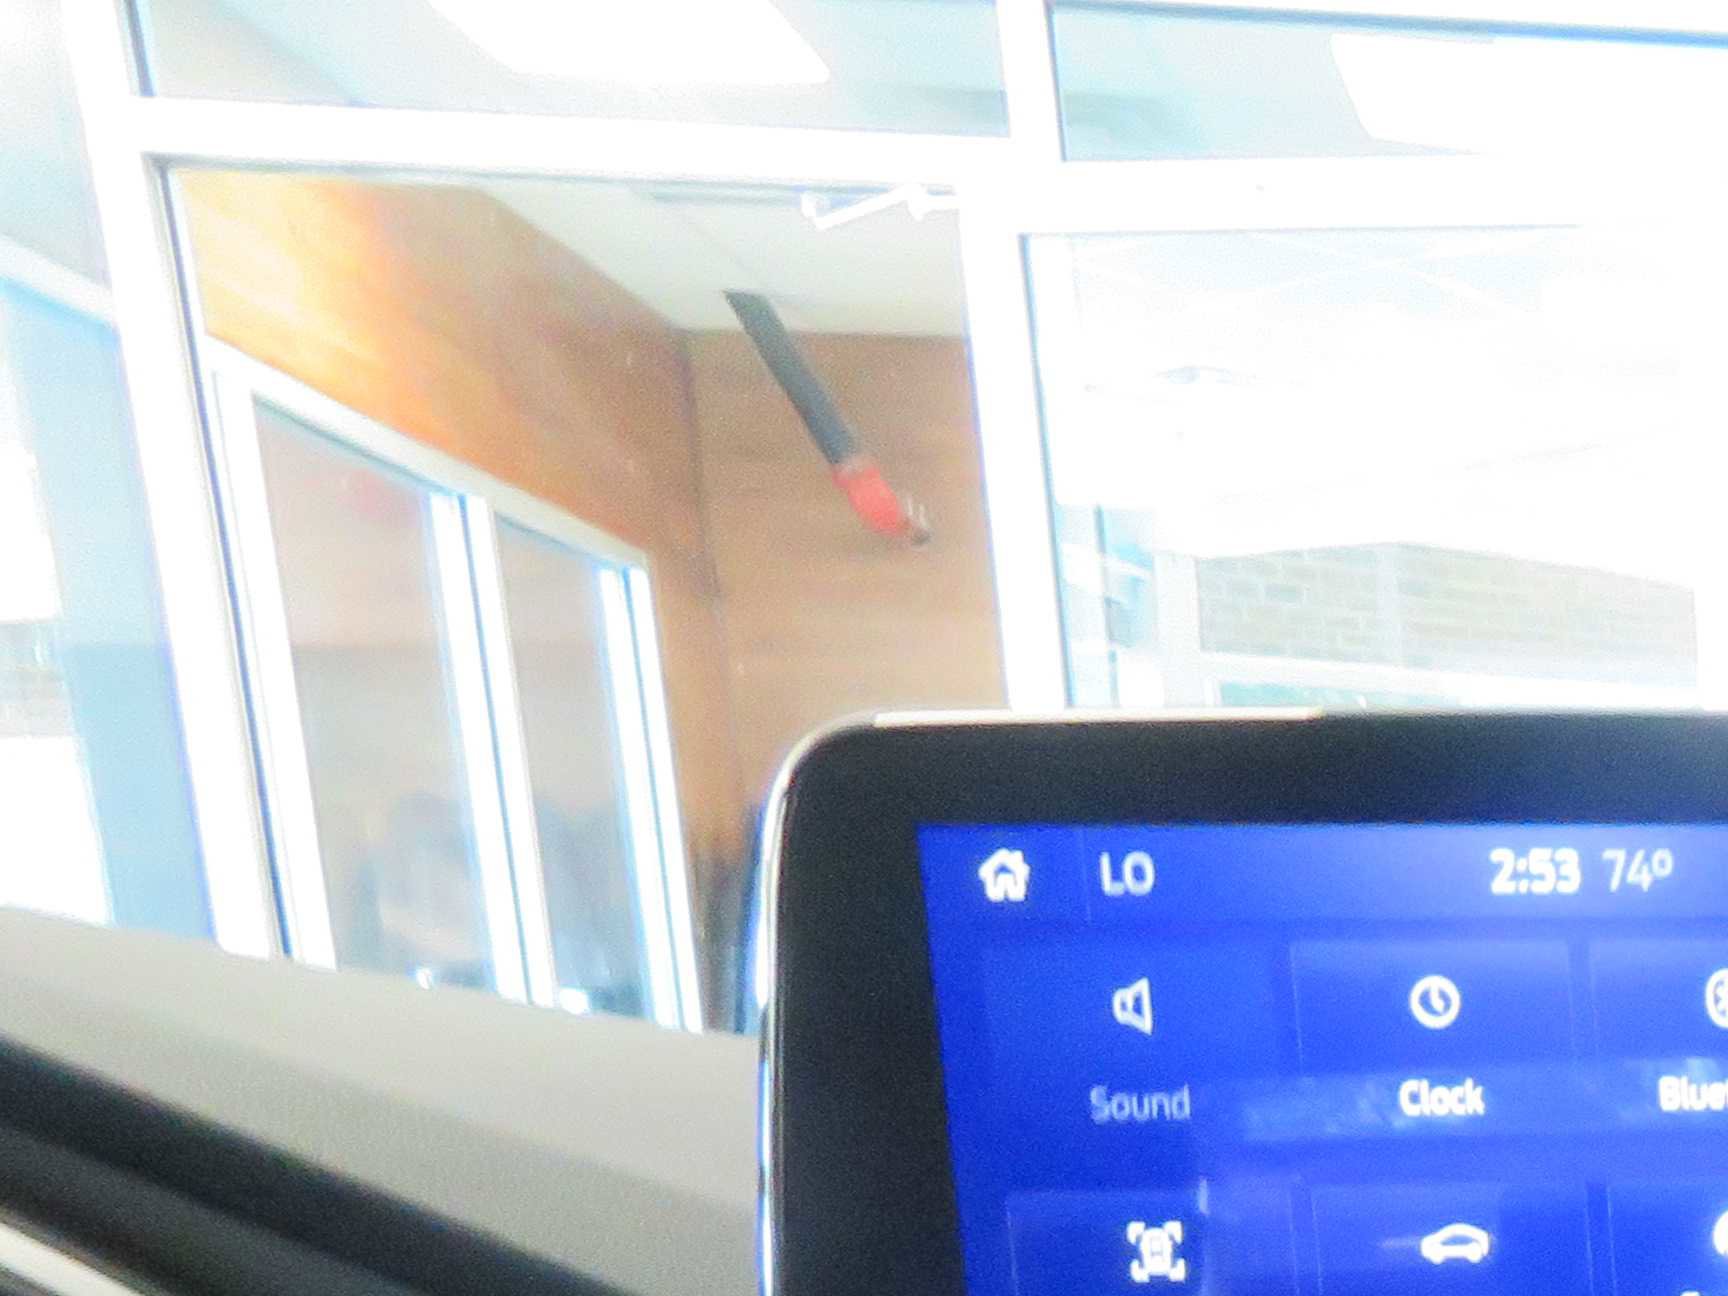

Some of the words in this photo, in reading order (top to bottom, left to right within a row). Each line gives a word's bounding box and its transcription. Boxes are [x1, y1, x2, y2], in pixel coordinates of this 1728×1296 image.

[1101, 851, 1155, 896] LO
[1490, 848, 1581, 894] 2:53
[1090, 1085, 1191, 1124] Sound
[1400, 1078, 1485, 1116] Clock
